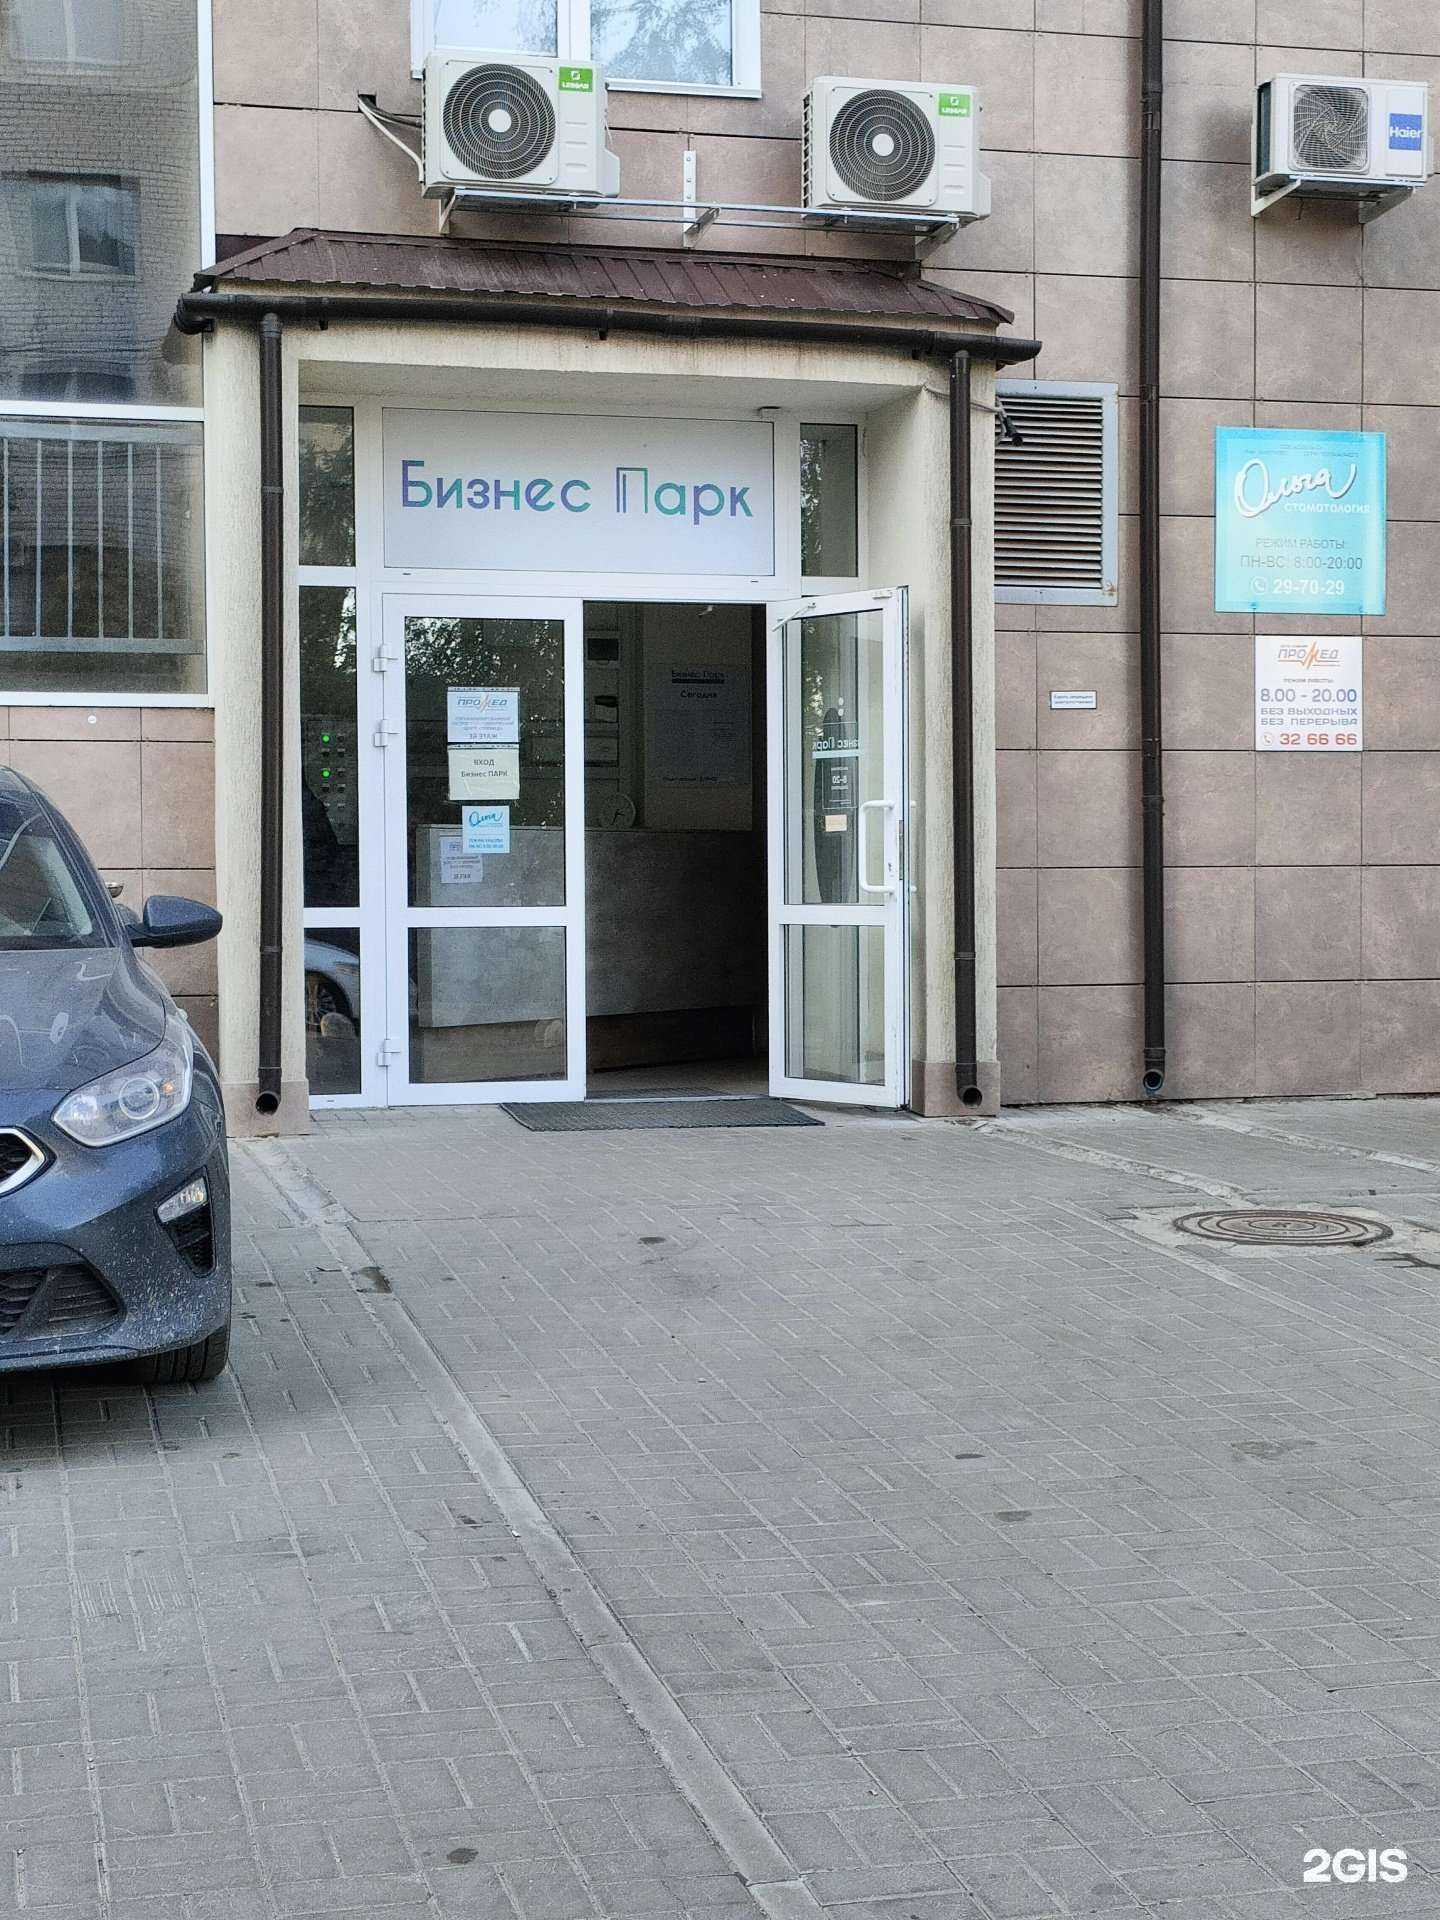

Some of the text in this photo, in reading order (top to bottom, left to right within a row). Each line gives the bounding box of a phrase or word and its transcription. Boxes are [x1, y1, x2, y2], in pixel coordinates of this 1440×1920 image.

[1390, 126, 1424, 138] Haier
[401, 459, 754, 525] Бизнес Парк
[1255, 537, 1345, 550] РЕЖИМ РАБОТЫ
[1294, 556, 1363, 570] 8:00-20:00
[1273, 578, 1345, 596] 29-70-29
[1260, 688, 1296, 702] 8.00
[1311, 688, 1358, 703] 20.00
[1260, 707, 1358, 716] БЕЗ ВЫХОДНЫХ
[1260, 717, 1358, 726] БЕЗ ПЕРЕРЫВА
[1279, 732, 1358, 746] 32 66 66
[473, 759, 495, 767] ВХОД
